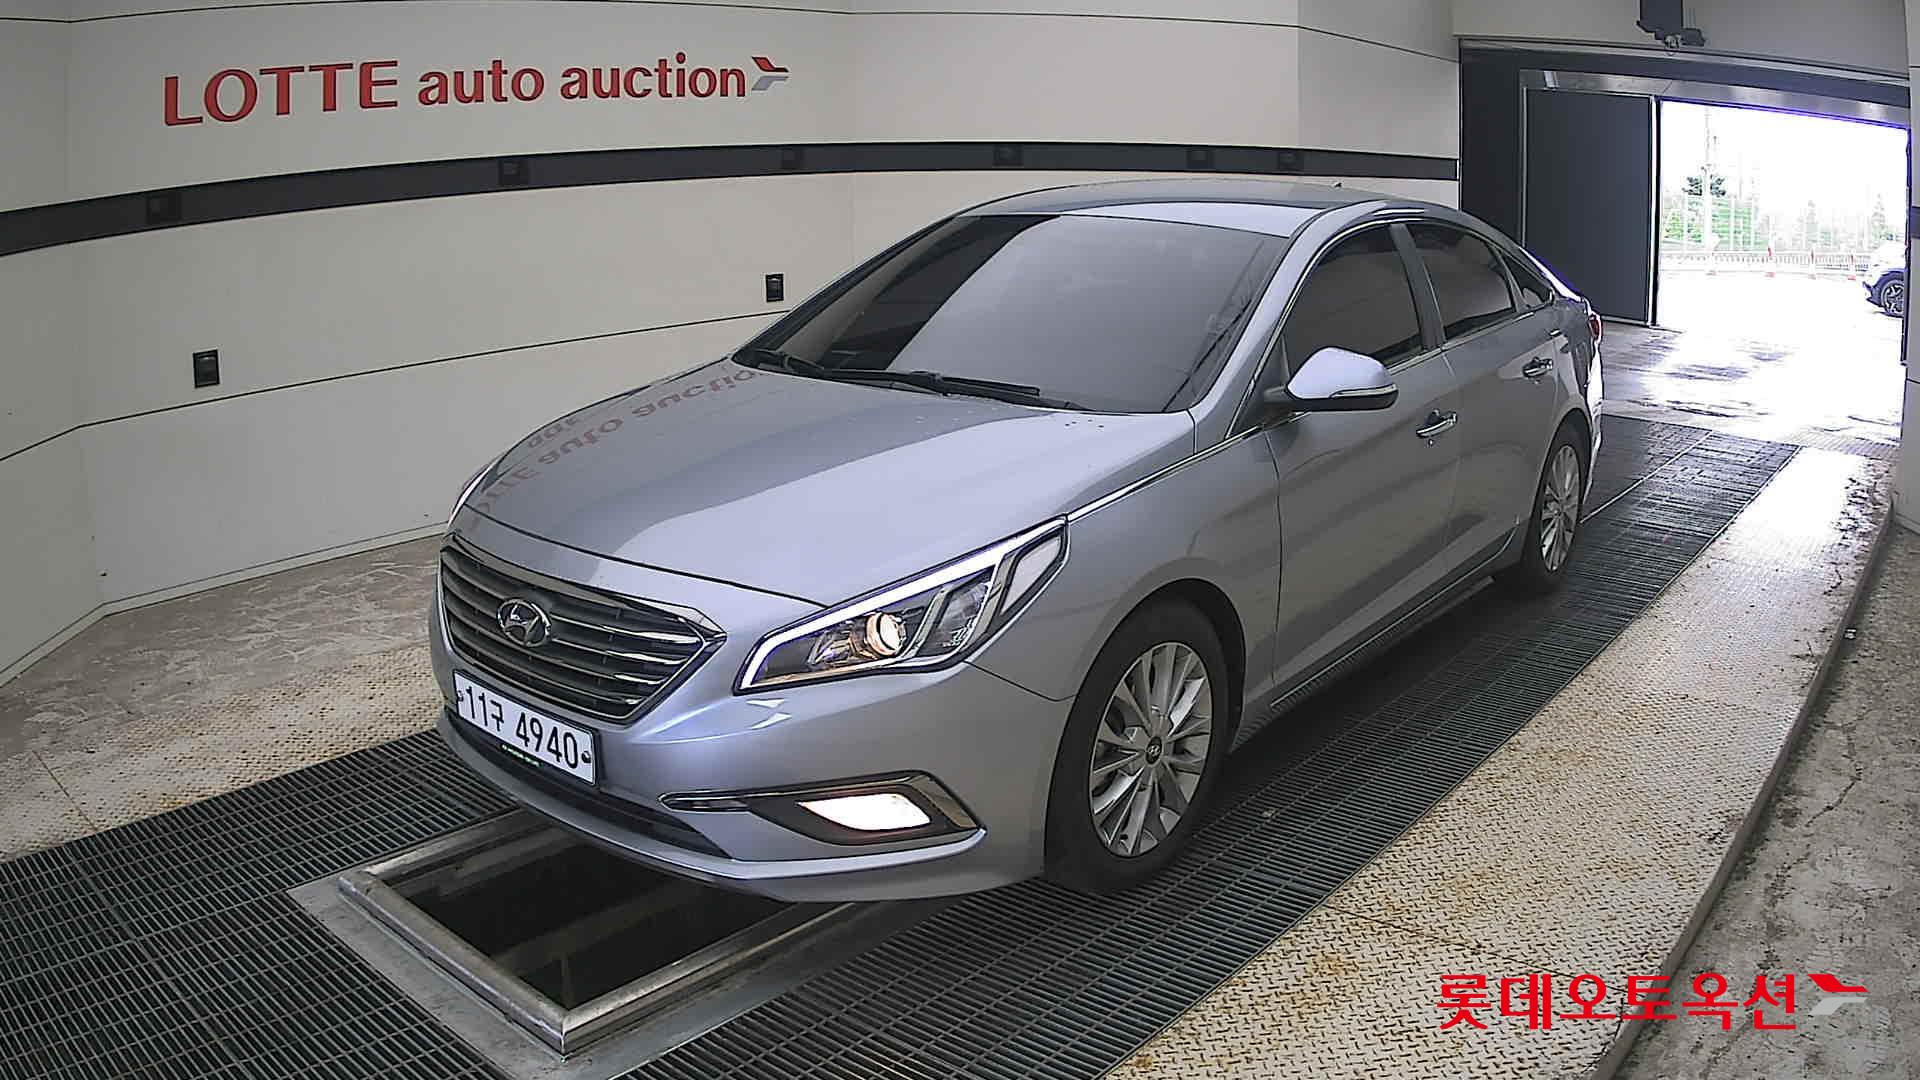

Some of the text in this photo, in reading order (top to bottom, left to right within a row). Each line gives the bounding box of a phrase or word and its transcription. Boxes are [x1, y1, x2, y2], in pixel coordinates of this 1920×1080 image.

[164, 51, 747, 127] LOTTE auto auction
[465, 686, 504, 731] 11구
[515, 712, 578, 769] 4940
